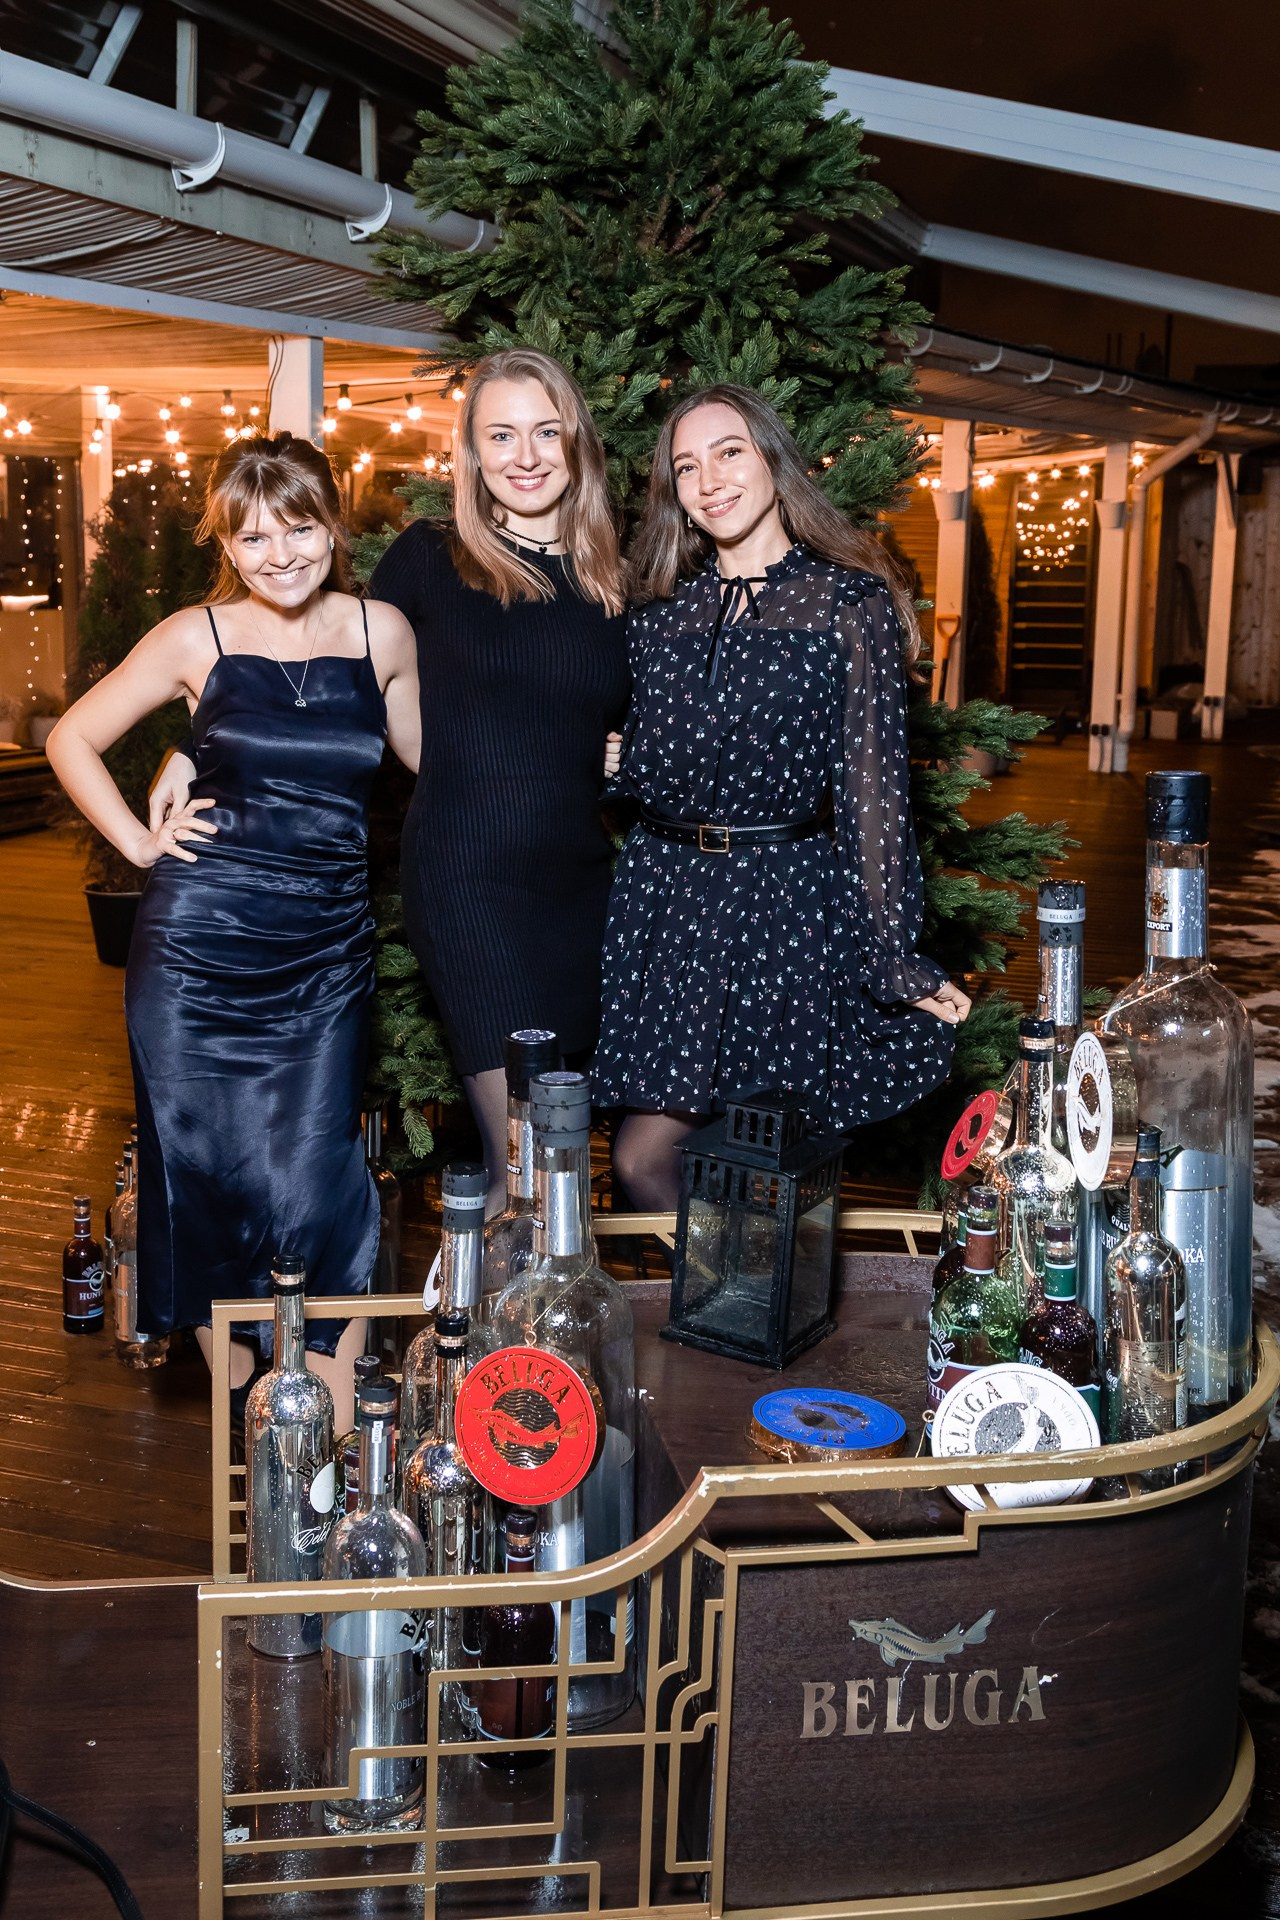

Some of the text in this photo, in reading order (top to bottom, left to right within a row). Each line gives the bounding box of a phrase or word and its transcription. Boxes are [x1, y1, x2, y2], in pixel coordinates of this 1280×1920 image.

[480, 1360, 571, 1405] BELUGA
[946, 1380, 1003, 1457] ELUGA
[799, 1665, 1047, 1739] BELUGA
